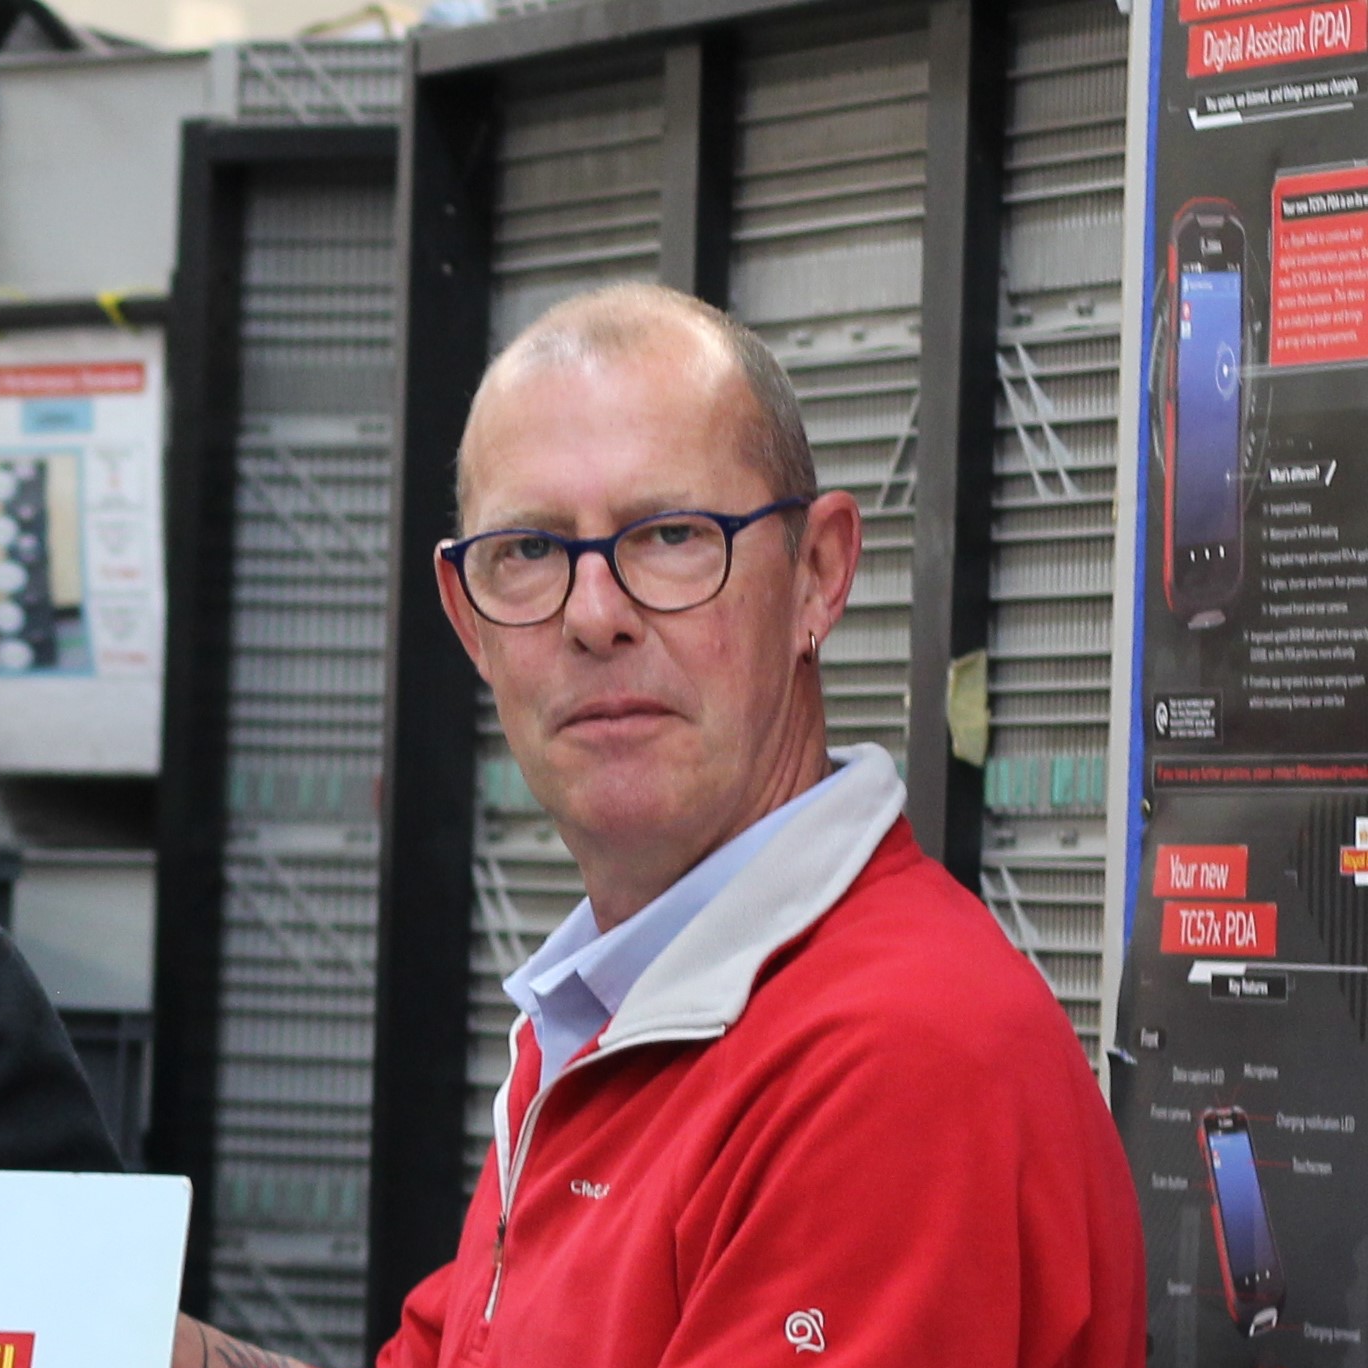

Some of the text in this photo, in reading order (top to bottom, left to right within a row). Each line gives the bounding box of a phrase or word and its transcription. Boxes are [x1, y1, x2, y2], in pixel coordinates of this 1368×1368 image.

[1203, 5, 1351, 73] Digital Assistant (PDA)
[1170, 853, 1229, 890] Your new
[1179, 908, 1257, 947] TC57x PDA
